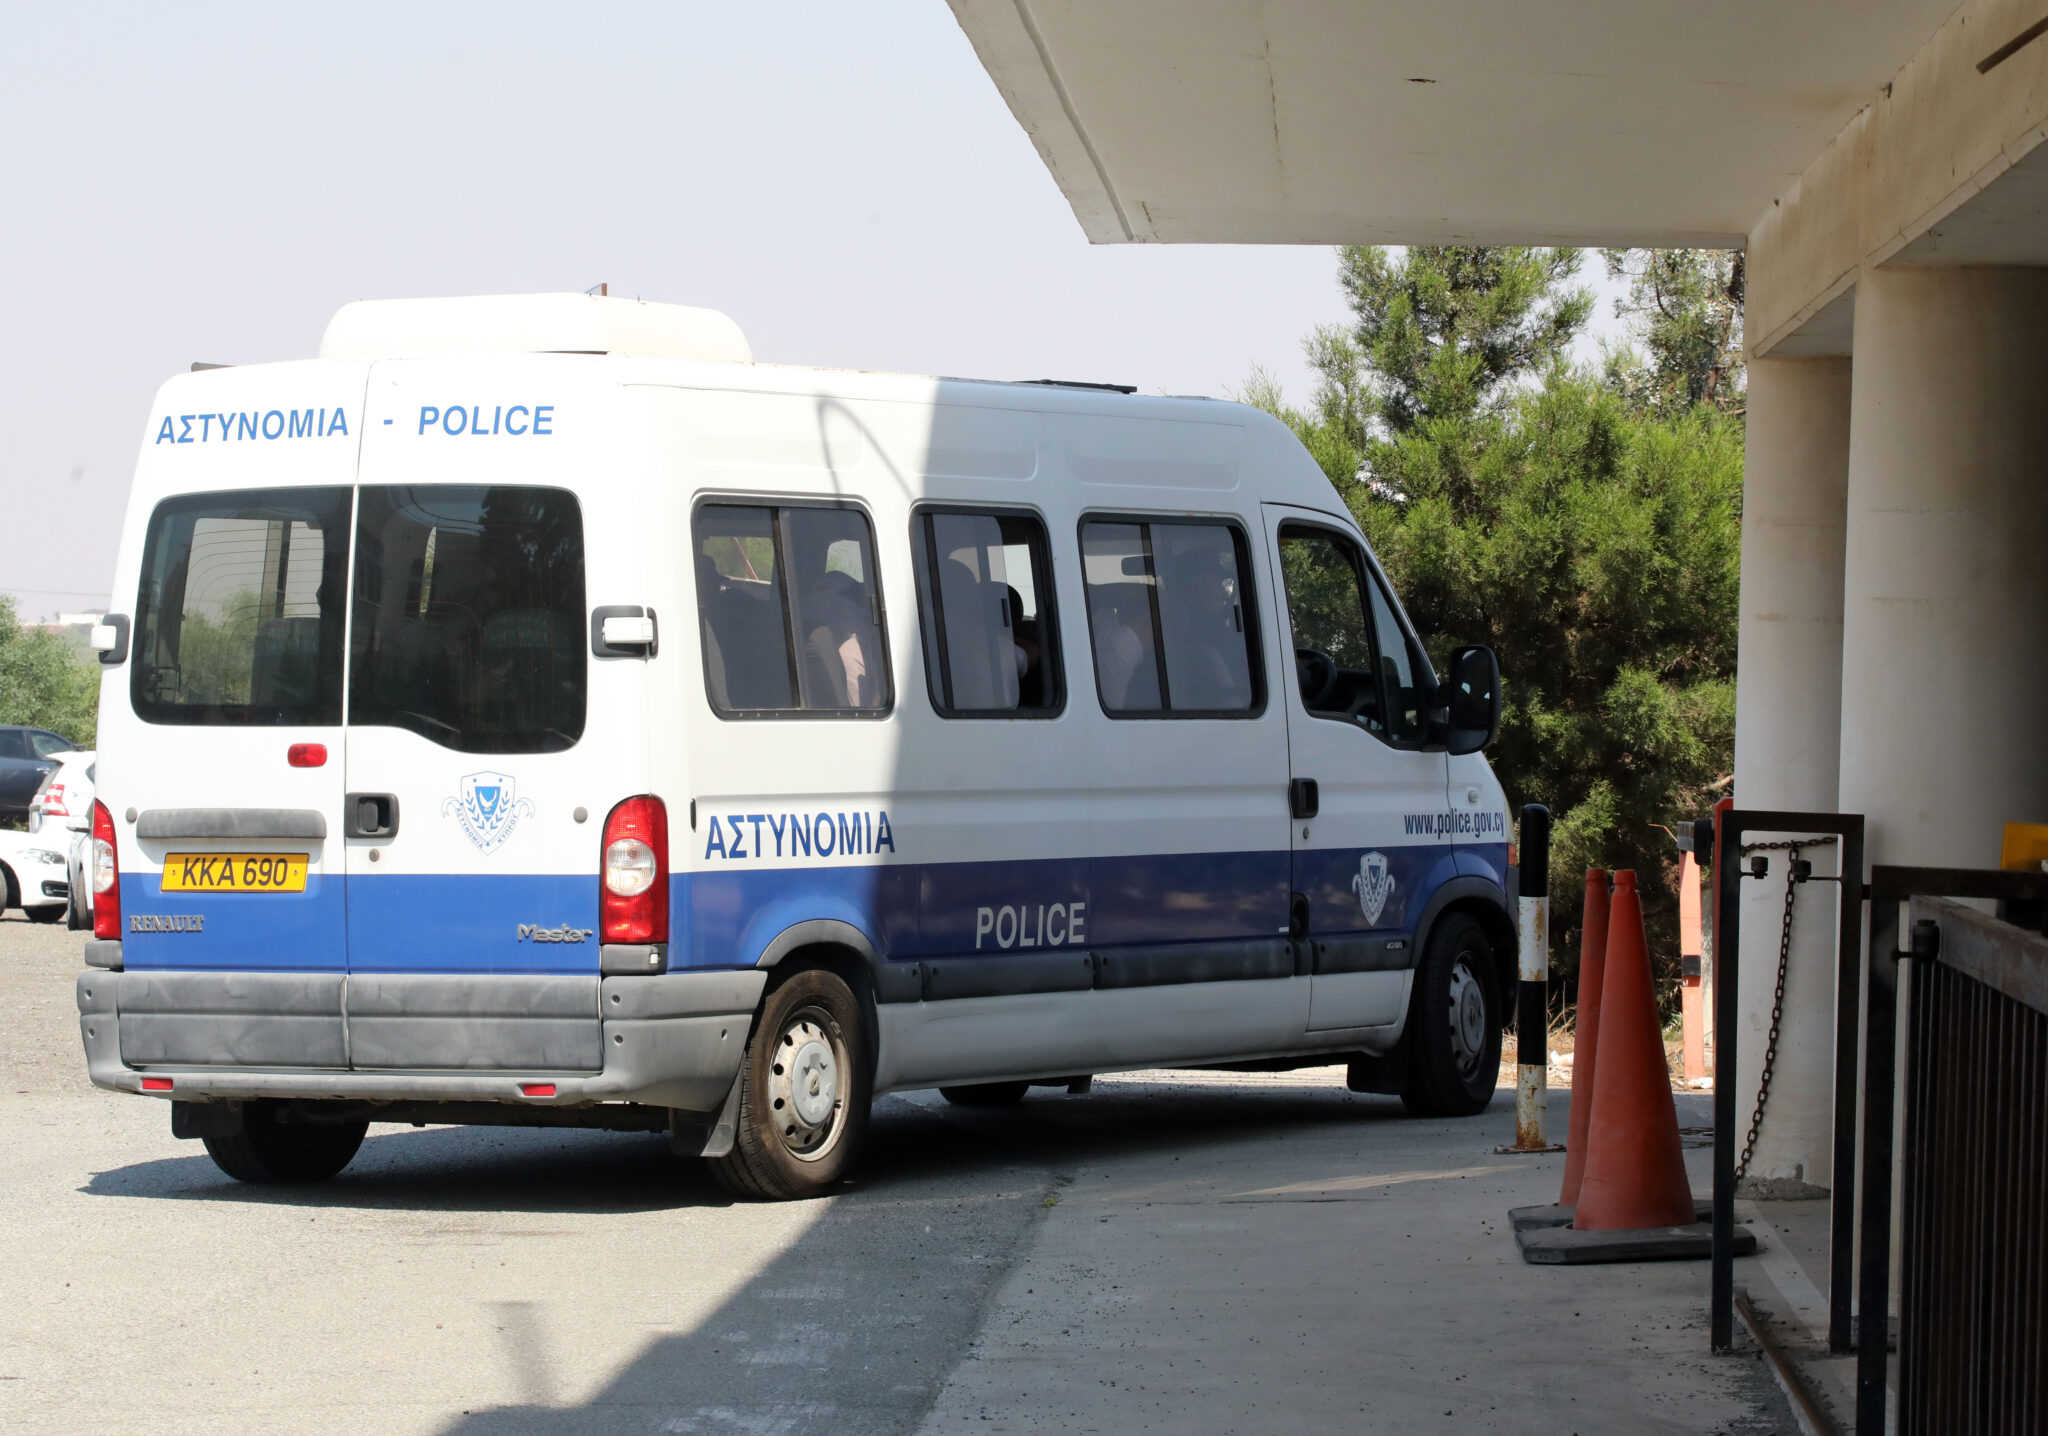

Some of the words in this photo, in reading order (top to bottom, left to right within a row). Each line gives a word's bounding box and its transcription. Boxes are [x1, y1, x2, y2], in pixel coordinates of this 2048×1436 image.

[155, 407, 349, 445] ΑΣΤΥΝΟΜΙΑ
[418, 406, 555, 436] POLICE
[704, 810, 896, 861] ΑΣΤΥΝΟΜΙΑ
[1403, 807, 1505, 840] www.police.gov.cy
[181, 857, 235, 887] KKA
[242, 857, 288, 887] 690
[129, 914, 205, 934] RENAULT
[517, 923, 593, 944] Master
[975, 902, 1086, 950] POLICE
